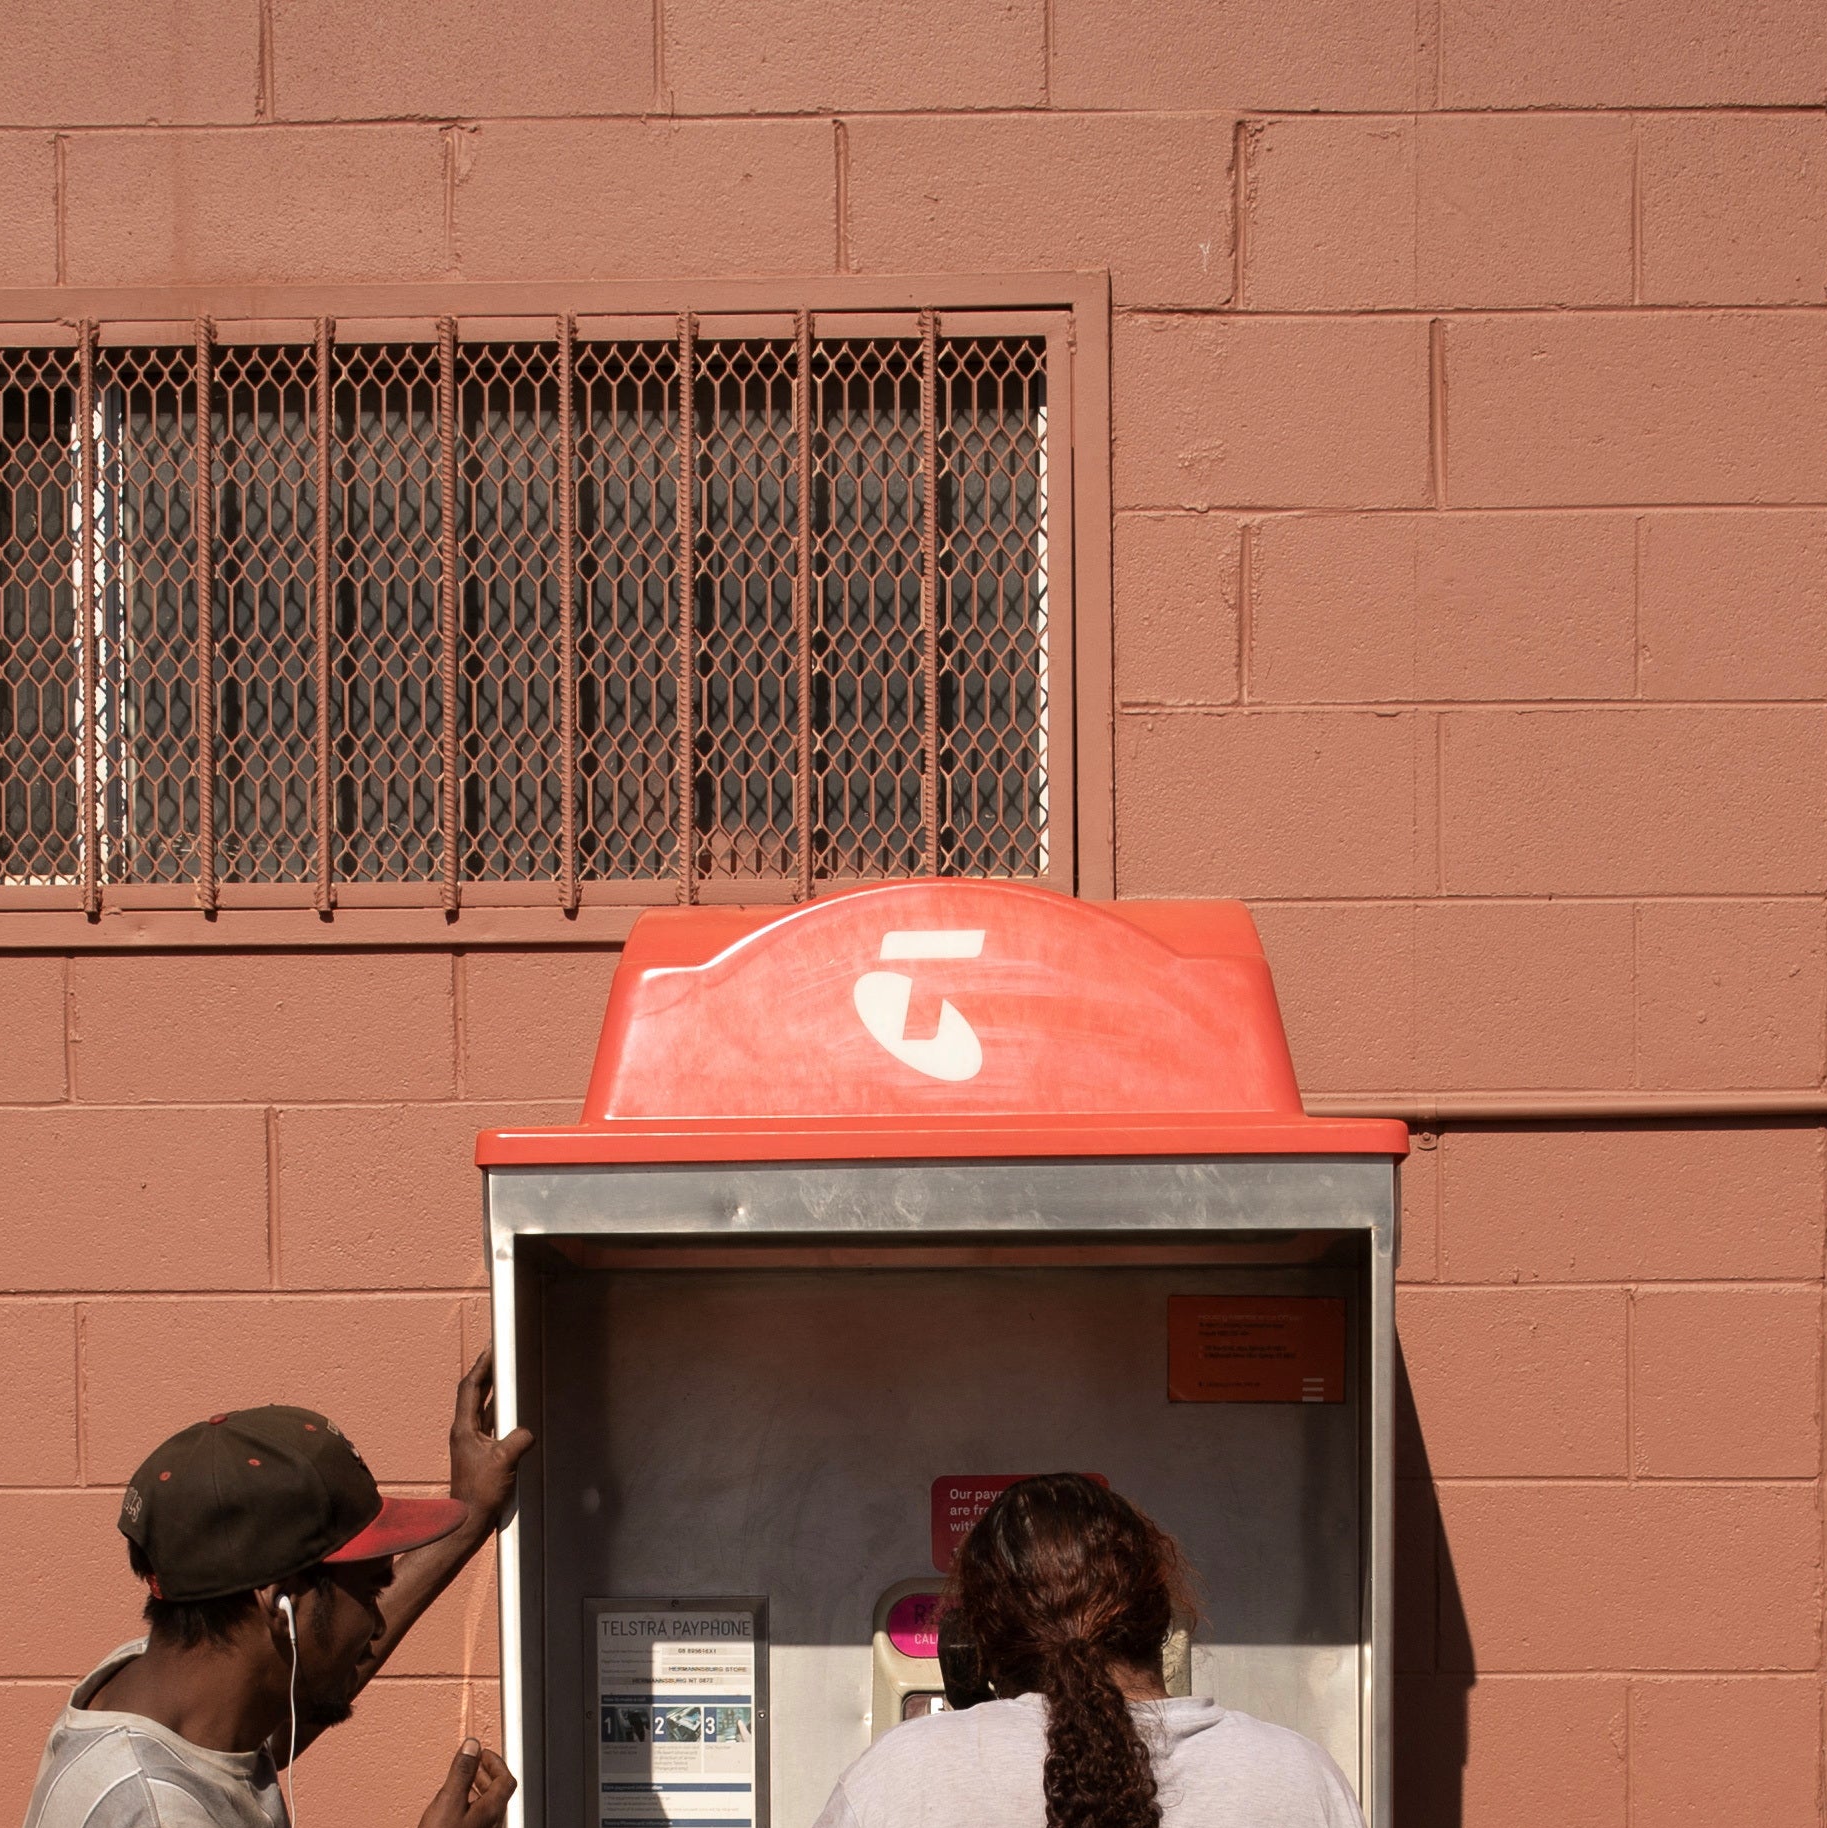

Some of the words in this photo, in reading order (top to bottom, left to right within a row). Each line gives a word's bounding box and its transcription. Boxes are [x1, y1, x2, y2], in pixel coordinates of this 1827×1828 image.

[950, 1488, 972, 1500] Our
[950, 1507, 970, 1516] are
[601, 1620, 667, 1636] TELSTRA
[672, 1620, 751, 1636] PAYPHONE
[604, 1717, 612, 1735] 1
[654, 1716, 665, 1735] 2
[705, 1716, 715, 1735] 3
